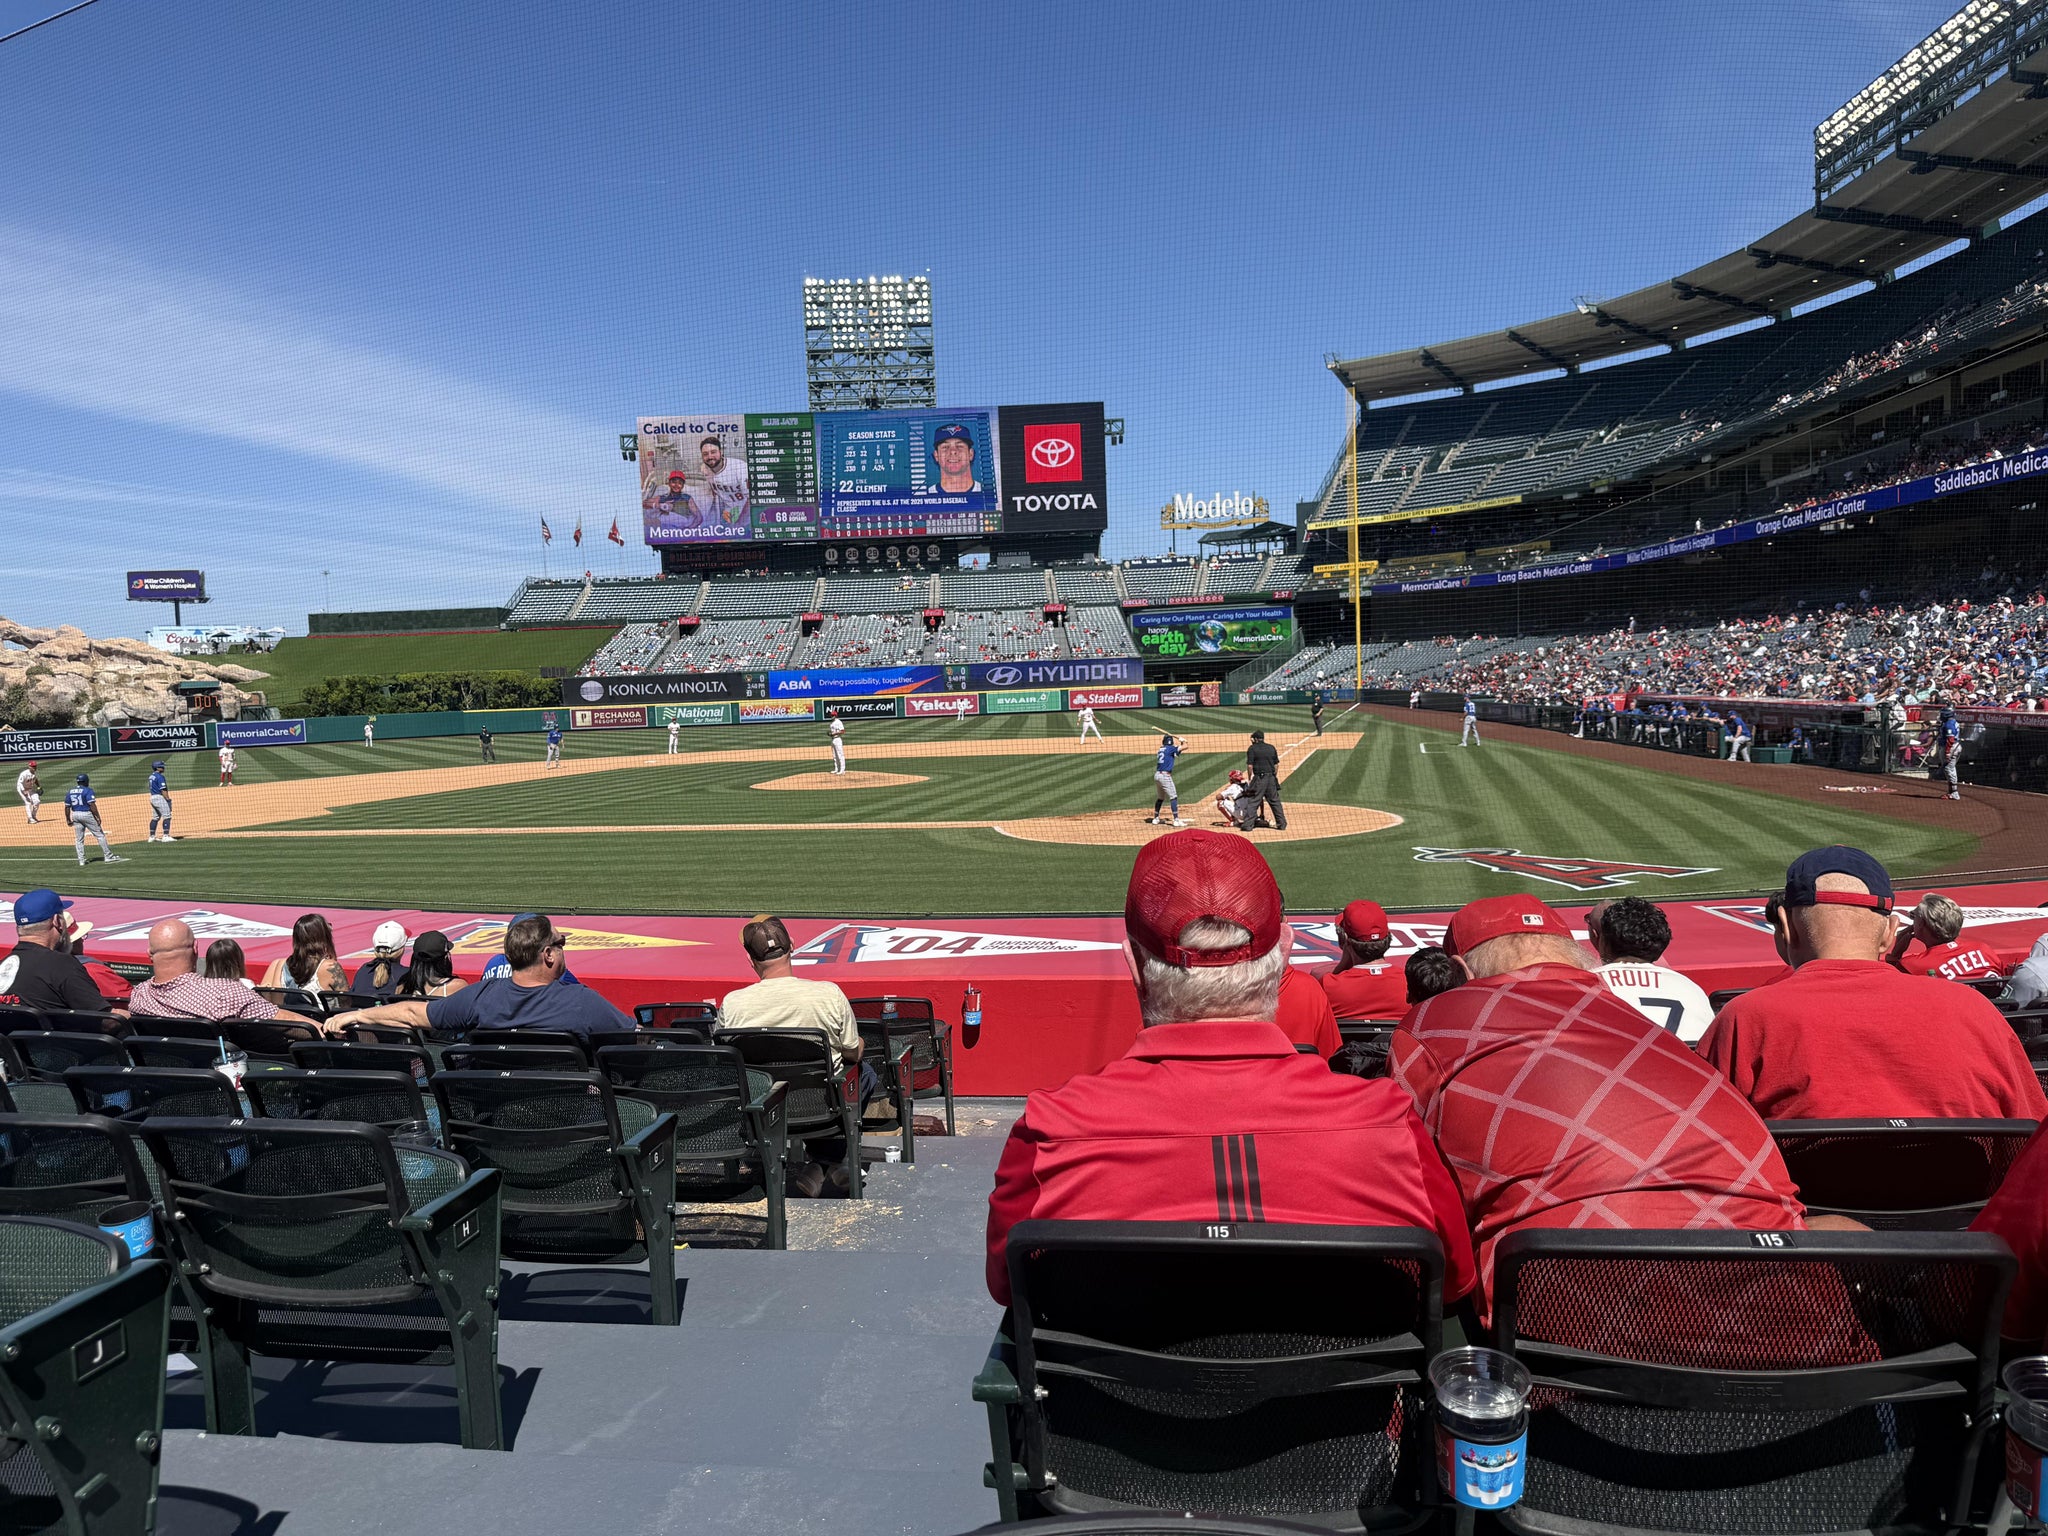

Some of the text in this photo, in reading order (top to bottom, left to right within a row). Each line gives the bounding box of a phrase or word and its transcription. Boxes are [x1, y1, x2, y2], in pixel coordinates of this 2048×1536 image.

[643, 422, 738, 434] Called to Care
[848, 430, 896, 440] SEASON STATS
[1934, 464, 2000, 493] Saddleback
[840, 480, 854, 492] 22
[856, 485, 887, 493] CLEMENT
[731, 492, 744, 502] 18
[1012, 493, 1097, 512] TOYOTA
[1174, 490, 1254, 520] Modelo
[776, 512, 787, 522] 68
[1756, 499, 1866, 534] Orange Coast Medical Center
[650, 525, 746, 538] MemorialCare
[929, 547, 938, 555] 50
[1626, 534, 1715, 564] Miller Children's & Women's Hospital
[1498, 563, 1592, 584] Long Beach Medical Center
[1401, 580, 1460, 592] MemorialCare
[1140, 616, 1161, 624] Caring
[166, 633, 199, 644] Coors
[1141, 630, 1184, 645] earth
[1233, 634, 1284, 643] MemorialCare
[1159, 642, 1187, 656] day
[1029, 664, 1128, 682] HYUNDAI
[778, 680, 812, 690] ABM
[819, 676, 914, 687] Driving possibility, together.
[609, 681, 727, 696] KONICA MINOLTA
[761, 689, 765, 697] 0
[1088, 694, 1138, 707] StateFarm
[676, 706, 724, 718] National
[744, 705, 786, 716] Surfside
[826, 702, 894, 713] NITTO TIRE.COM
[1986, 714, 2012, 724] StateFarm
[3, 734, 30, 742] JUST
[136, 727, 197, 738] YOKOHAMA
[222, 728, 288, 740] MemorialCare
[4, 739, 87, 752] INGREDIENTS
[170, 739, 198, 748] TIRES
[70, 794, 83, 805] 51
[887, 936, 983, 954] '04
[1939, 950, 1990, 980] STEEL
[771, 1111, 775, 1120] F
[1890, 1119, 1907, 1127] 115
[654, 1152, 658, 1162] G
[462, 1222, 470, 1236] H
[1206, 1226, 1229, 1238] 115
[1756, 1234, 1783, 1246] 115
[92, 1340, 104, 1363] J
